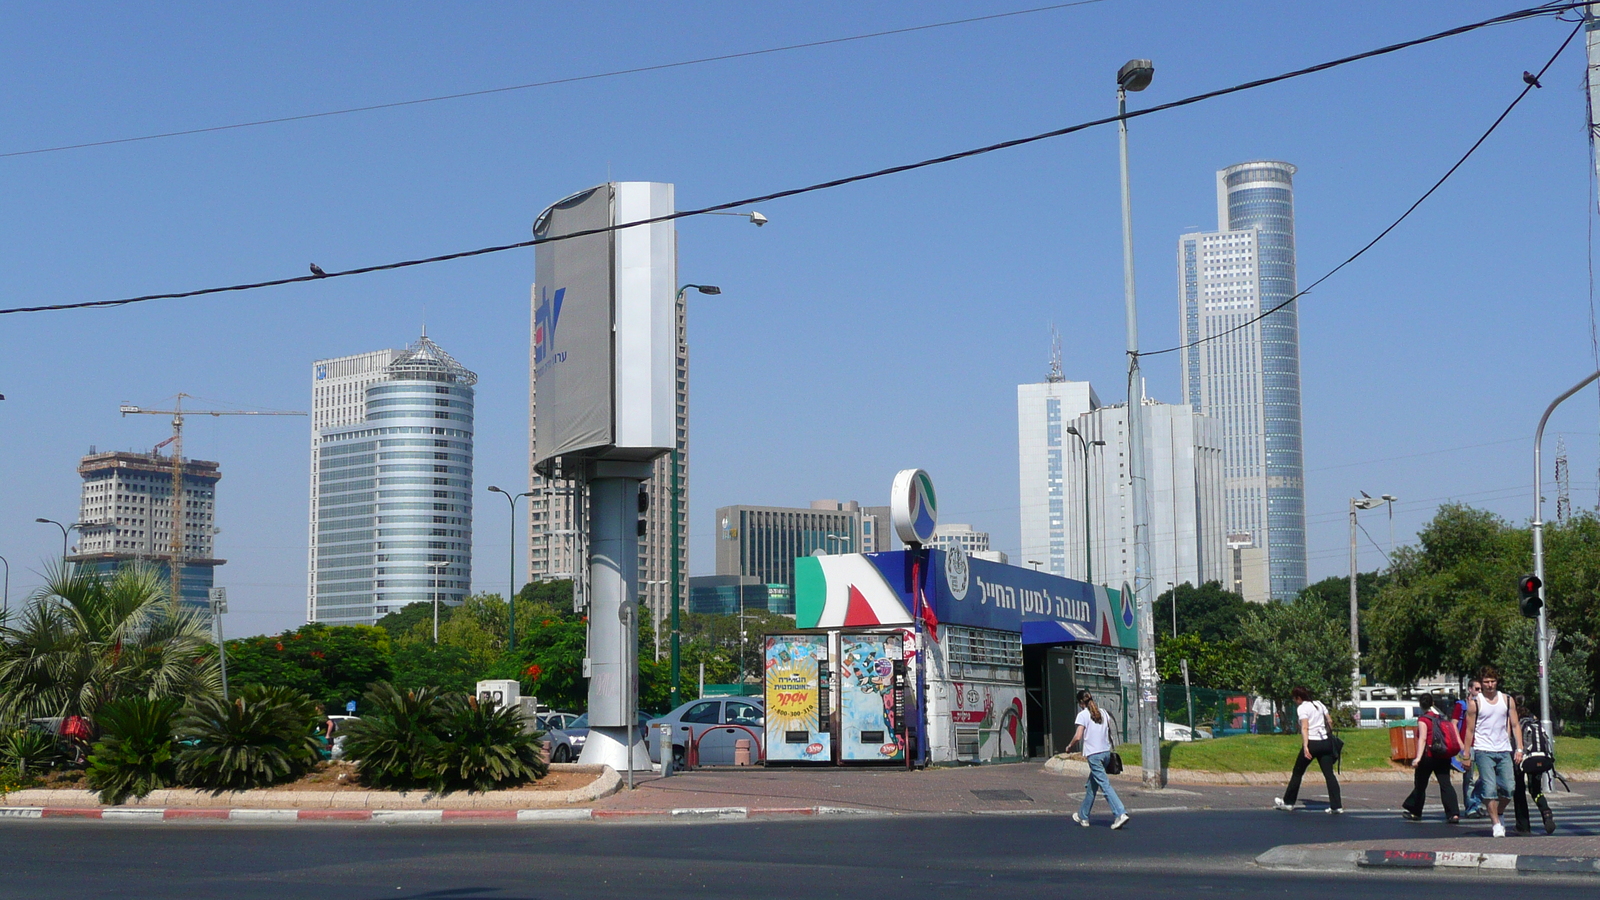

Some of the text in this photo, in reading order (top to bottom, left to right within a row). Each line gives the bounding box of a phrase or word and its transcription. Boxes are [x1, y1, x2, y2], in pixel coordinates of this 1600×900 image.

[976, 576, 1017, 610] החייל
[1020, 588, 1052, 616] למען
[1055, 595, 1090, 623] תנובה
